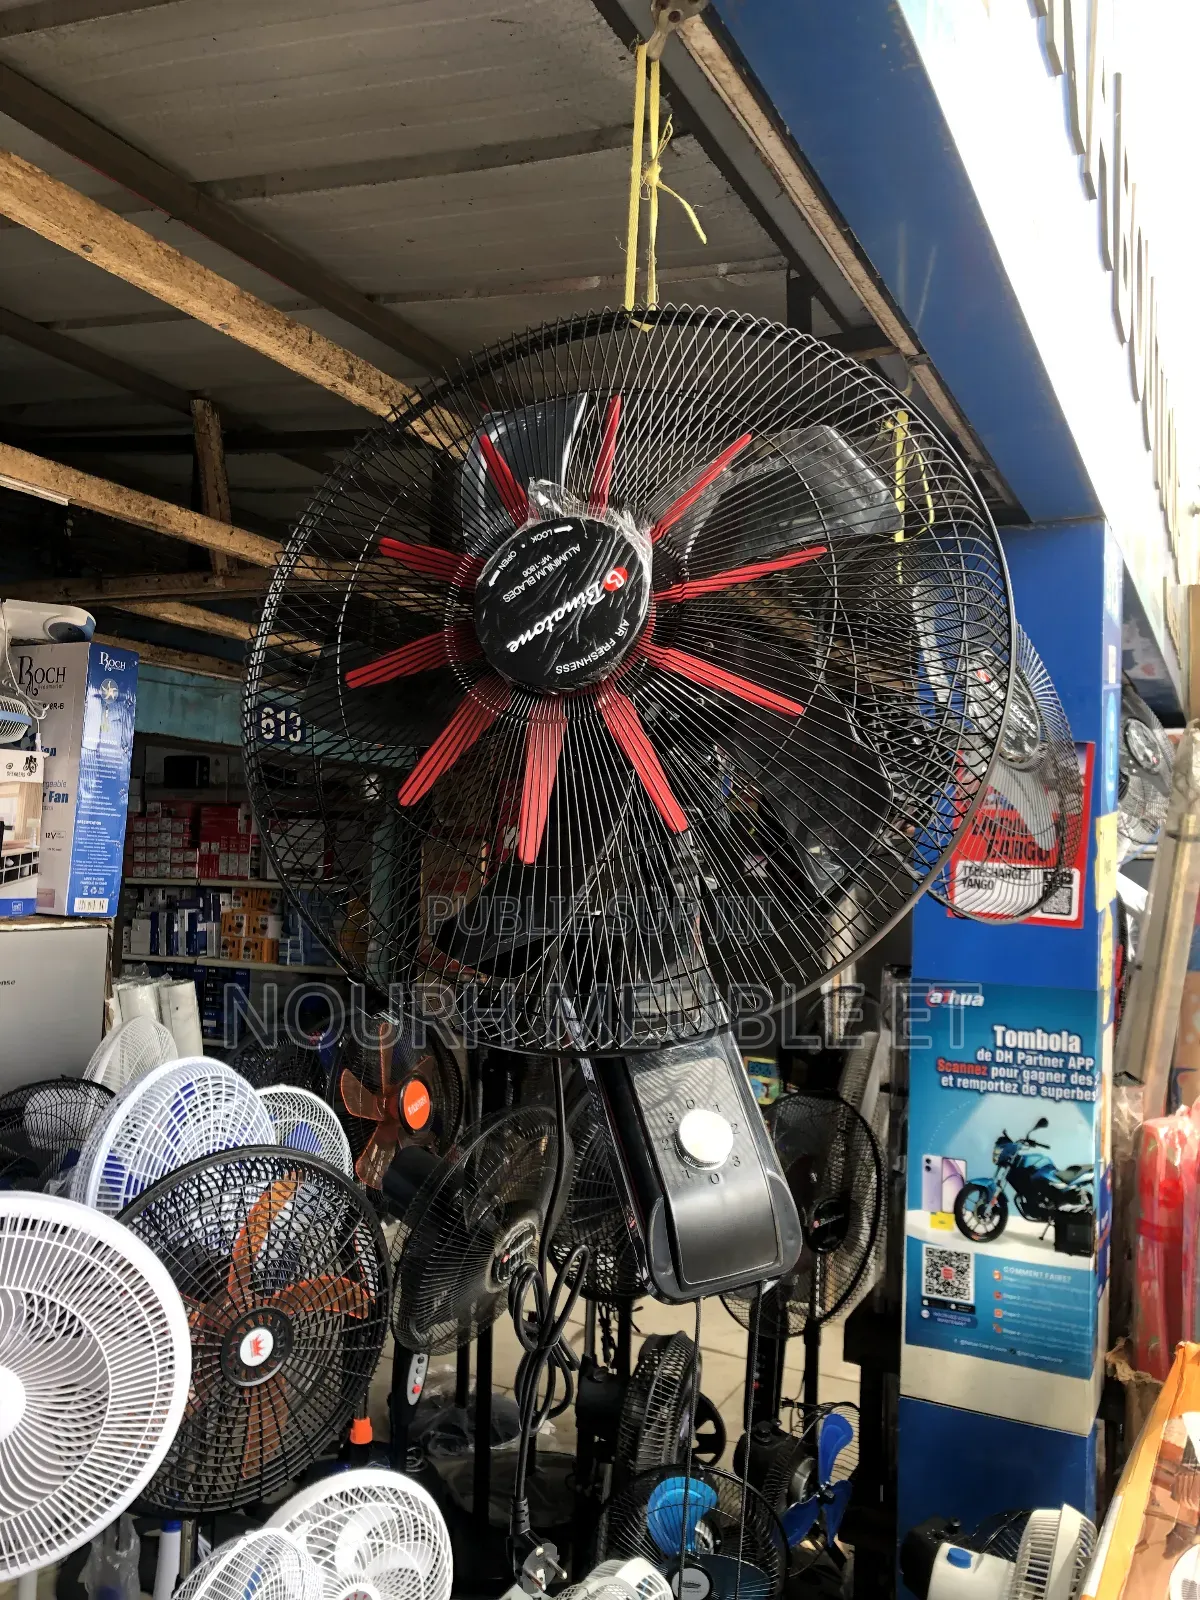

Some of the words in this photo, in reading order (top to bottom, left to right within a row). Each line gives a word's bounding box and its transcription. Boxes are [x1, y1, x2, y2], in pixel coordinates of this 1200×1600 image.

[499, 550, 517, 570] OPEN
[535, 543, 581, 581] ALUMINIUM
[502, 577, 537, 603] BLADES
[506, 580, 606, 653] Binatone
[614, 618, 630, 638] AIR
[99, 651, 126, 671] ROCH
[555, 637, 617, 674] FRESHNESS
[18, 655, 67, 697] ROCH
[261, 707, 302, 742] 613
[48, 791, 69, 803] Fan
[993, 1025, 1082, 1054] Tombola
[976, 1048, 992, 1062] de
[996, 1050, 1013, 1063] DH
[1017, 1051, 1064, 1068] Partner
[1068, 1056, 1094, 1071] APP
[937, 1059, 988, 1076] Scannez
[991, 1066, 1019, 1080] pour
[1022, 1069, 1067, 1085] gagner
[1070, 1071, 1093, 1086] des
[941, 1074, 954, 1087] et
[957, 1076, 1019, 1095] remportez
[1022, 1081, 1037, 1096] de
[731, 1123, 740, 1134] 2
[662, 1138, 672, 1150] 2
[710, 1173, 720, 1184] 0
[1003, 1265, 1043, 1278] COMMENT
